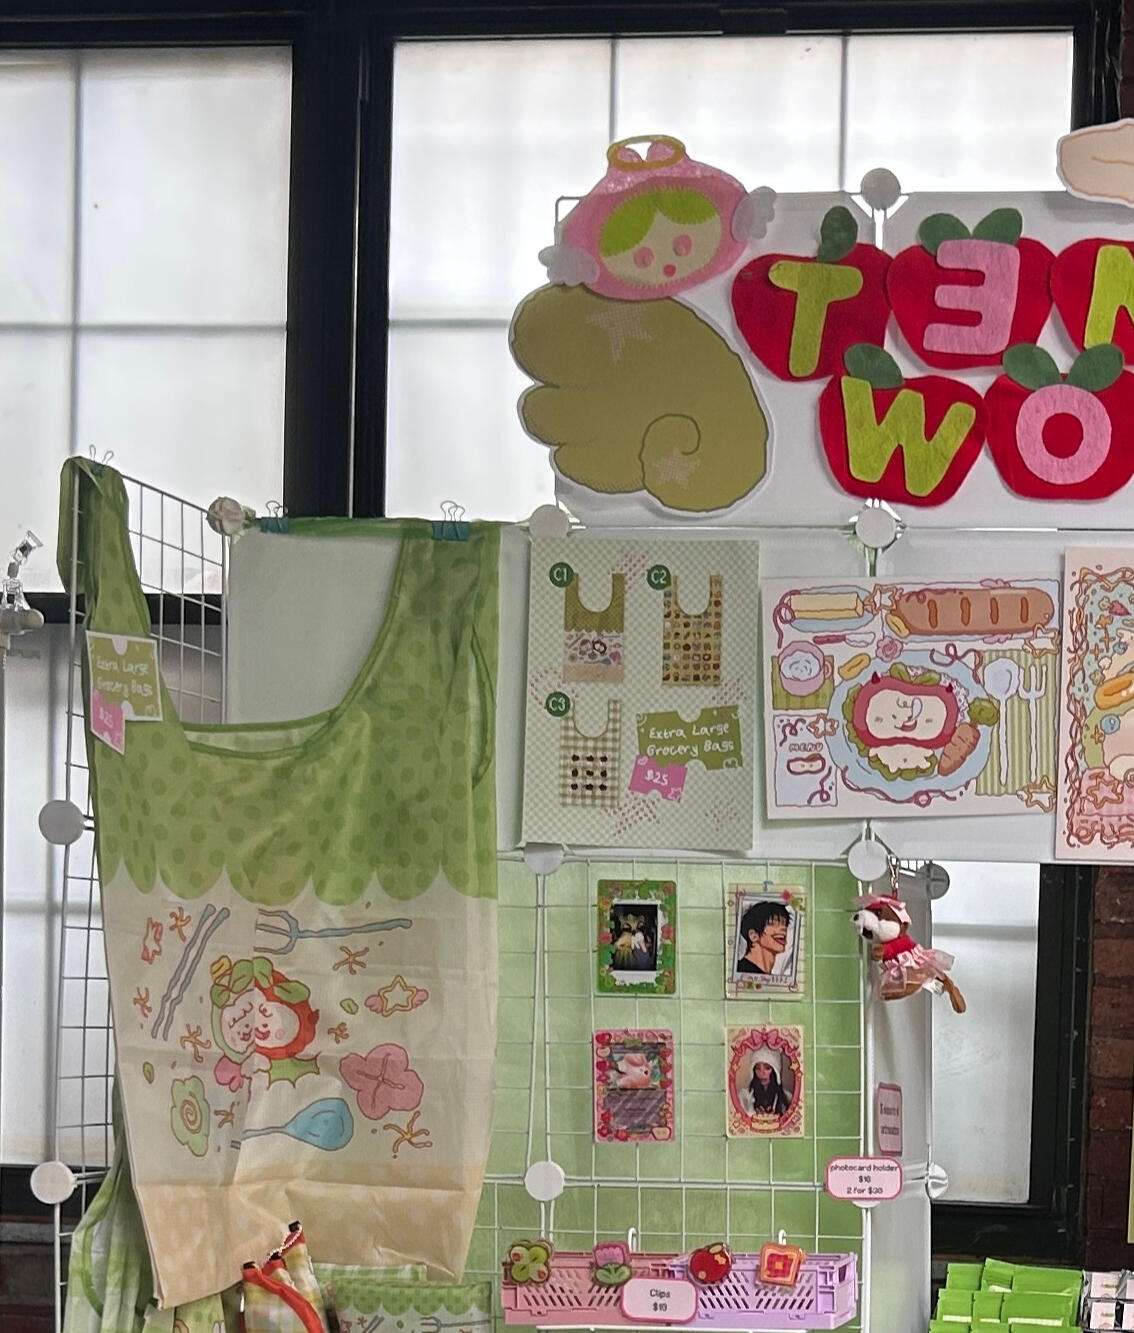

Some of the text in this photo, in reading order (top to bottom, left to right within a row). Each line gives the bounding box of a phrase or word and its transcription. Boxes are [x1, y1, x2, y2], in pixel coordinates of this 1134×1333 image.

[553, 568, 568, 582] C1
[651, 570, 667, 583] C2
[549, 698, 566, 711] C3
[649, 722, 729, 740] Extra Large
[647, 740, 735, 757] Grocery Bags
[645, 771, 669, 785] $25
[830, 1163, 898, 1172] photocard holder
[649, 1288, 671, 1299] Clips
